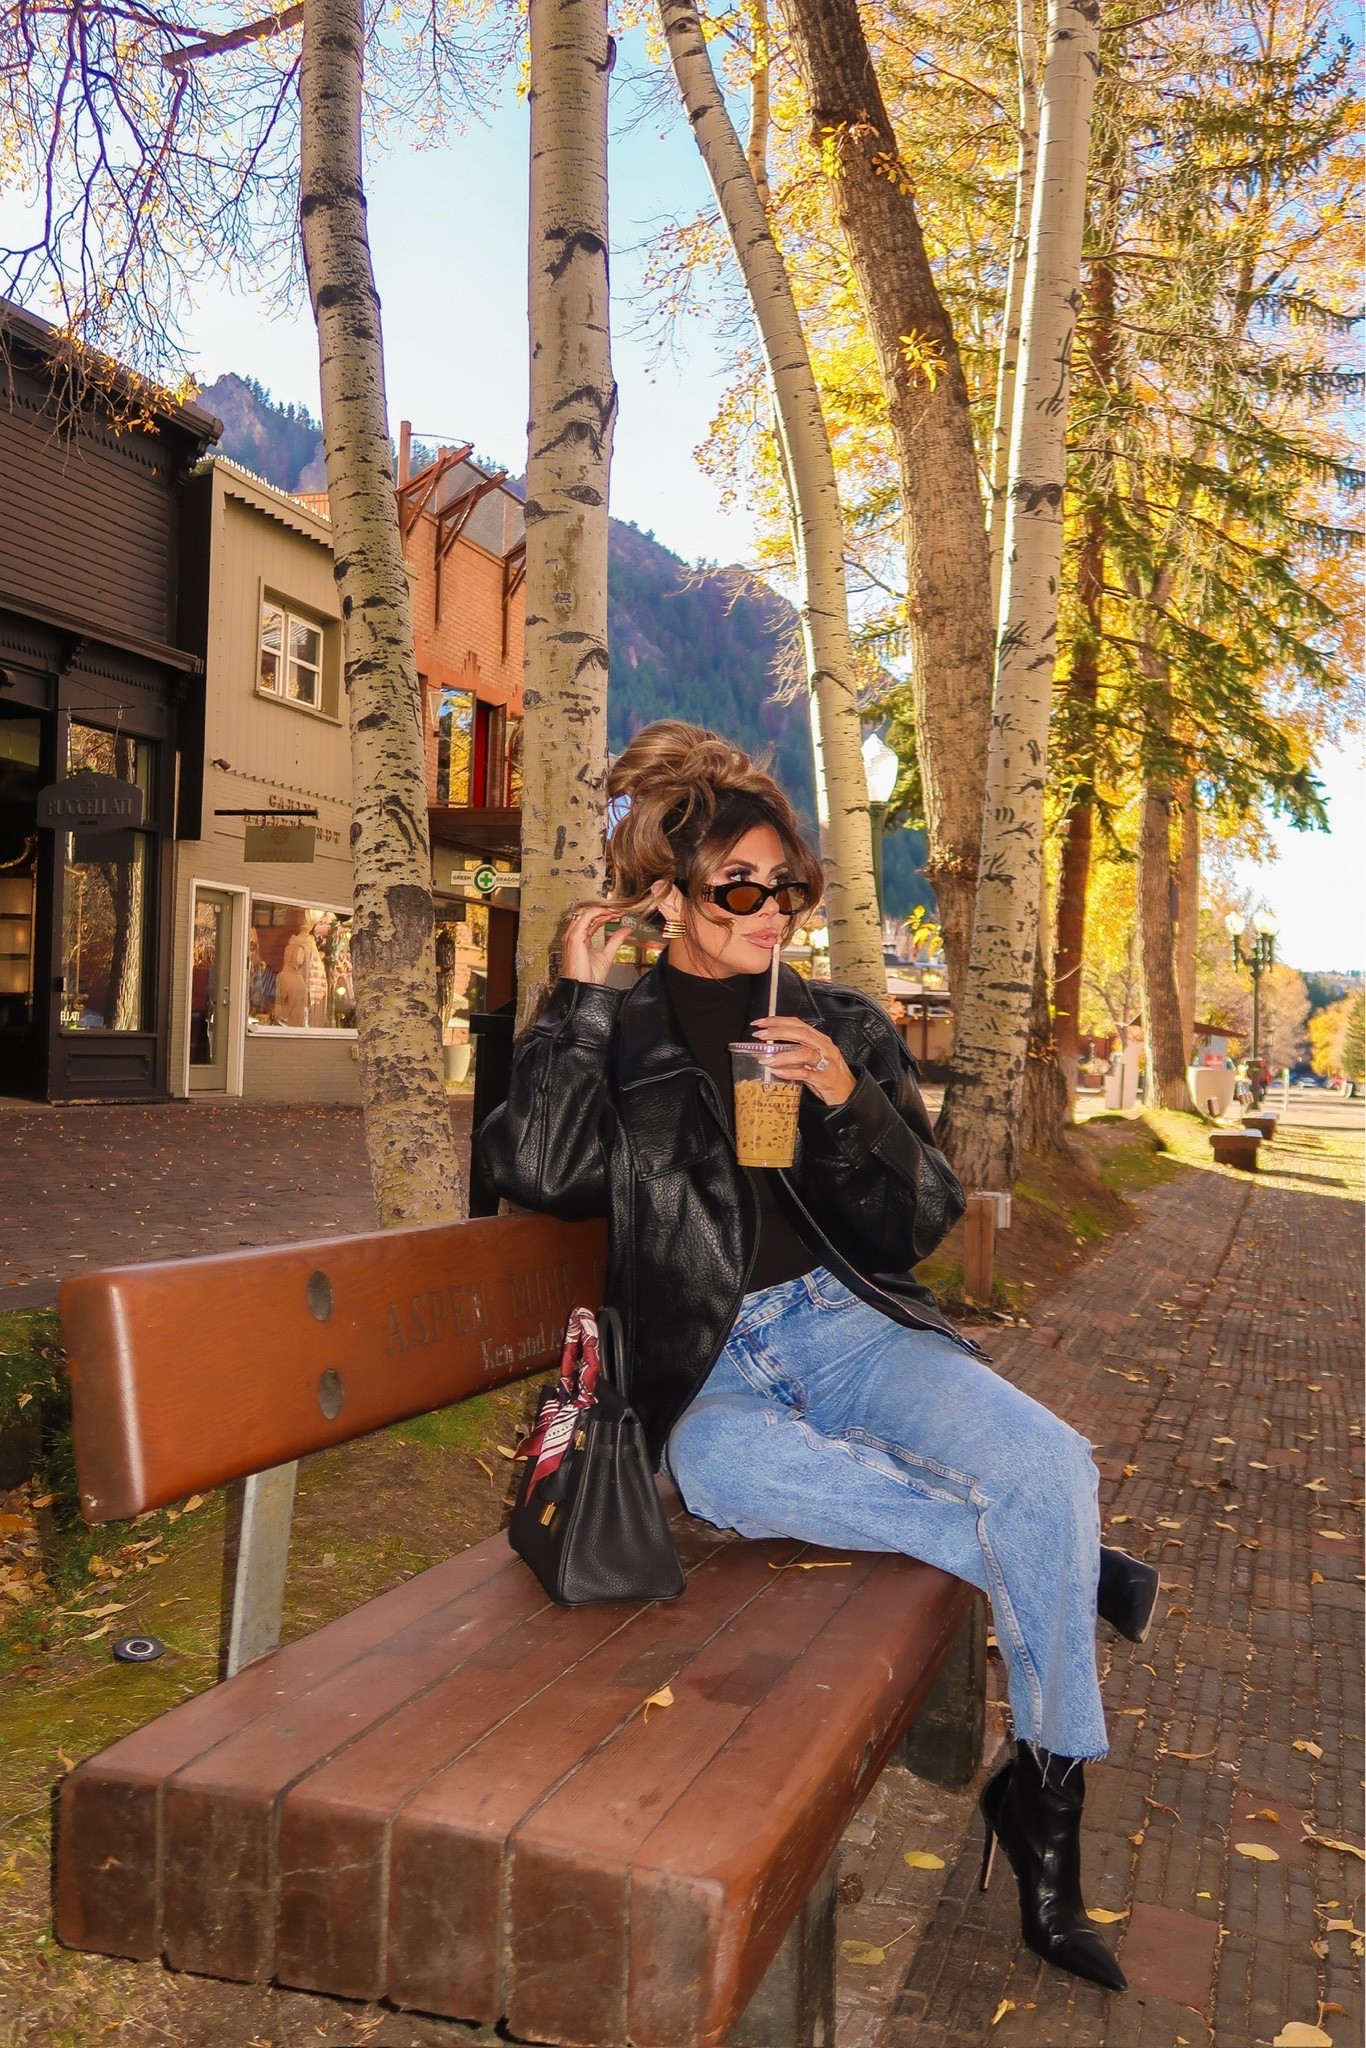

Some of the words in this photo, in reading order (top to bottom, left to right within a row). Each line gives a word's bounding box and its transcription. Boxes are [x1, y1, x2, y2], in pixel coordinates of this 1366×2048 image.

[48, 798, 132, 816] BUCCELLATI
[385, 1279, 489, 1358] ASPEN
[480, 1336, 515, 1371] Ken
[517, 1321, 546, 1360] and
